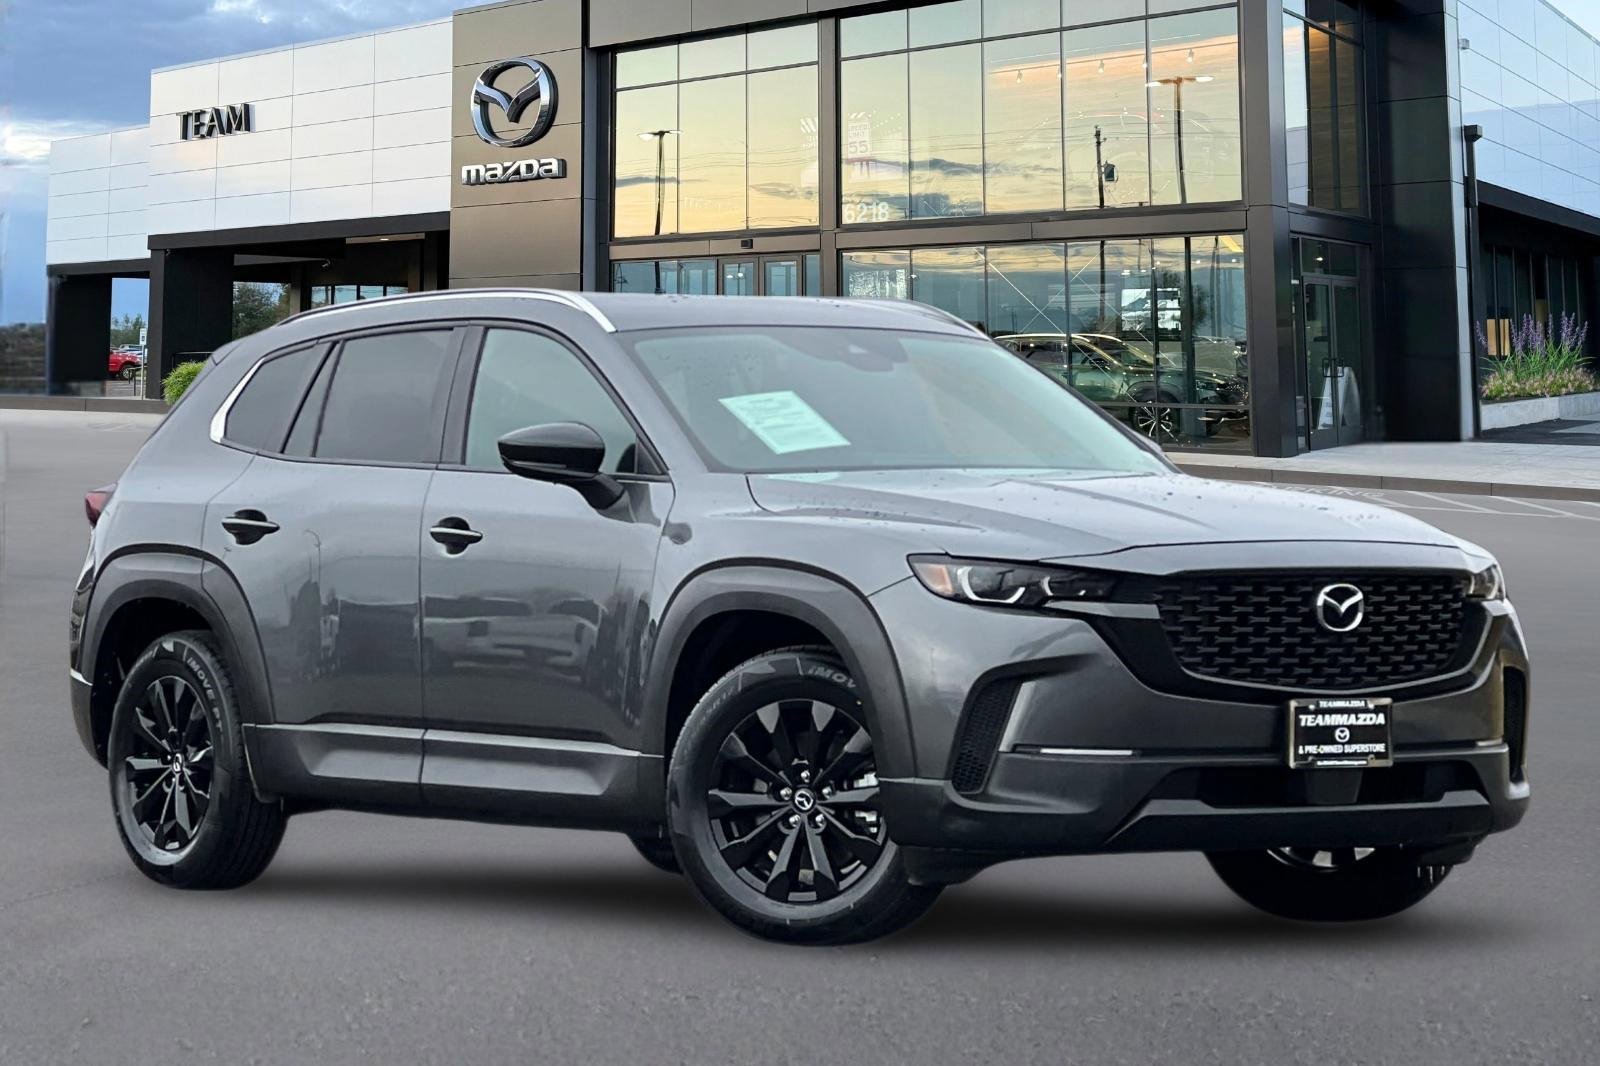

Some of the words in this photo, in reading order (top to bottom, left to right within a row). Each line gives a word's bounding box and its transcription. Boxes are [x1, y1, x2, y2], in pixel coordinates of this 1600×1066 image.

[176, 103, 252, 141] TEAM
[845, 201, 889, 223] 6218
[1299, 713, 1386, 727] TEAMMAZDA
[1304, 745, 1343, 754] PRE-OWNED
[1344, 743, 1386, 753] SUPERSTORE
